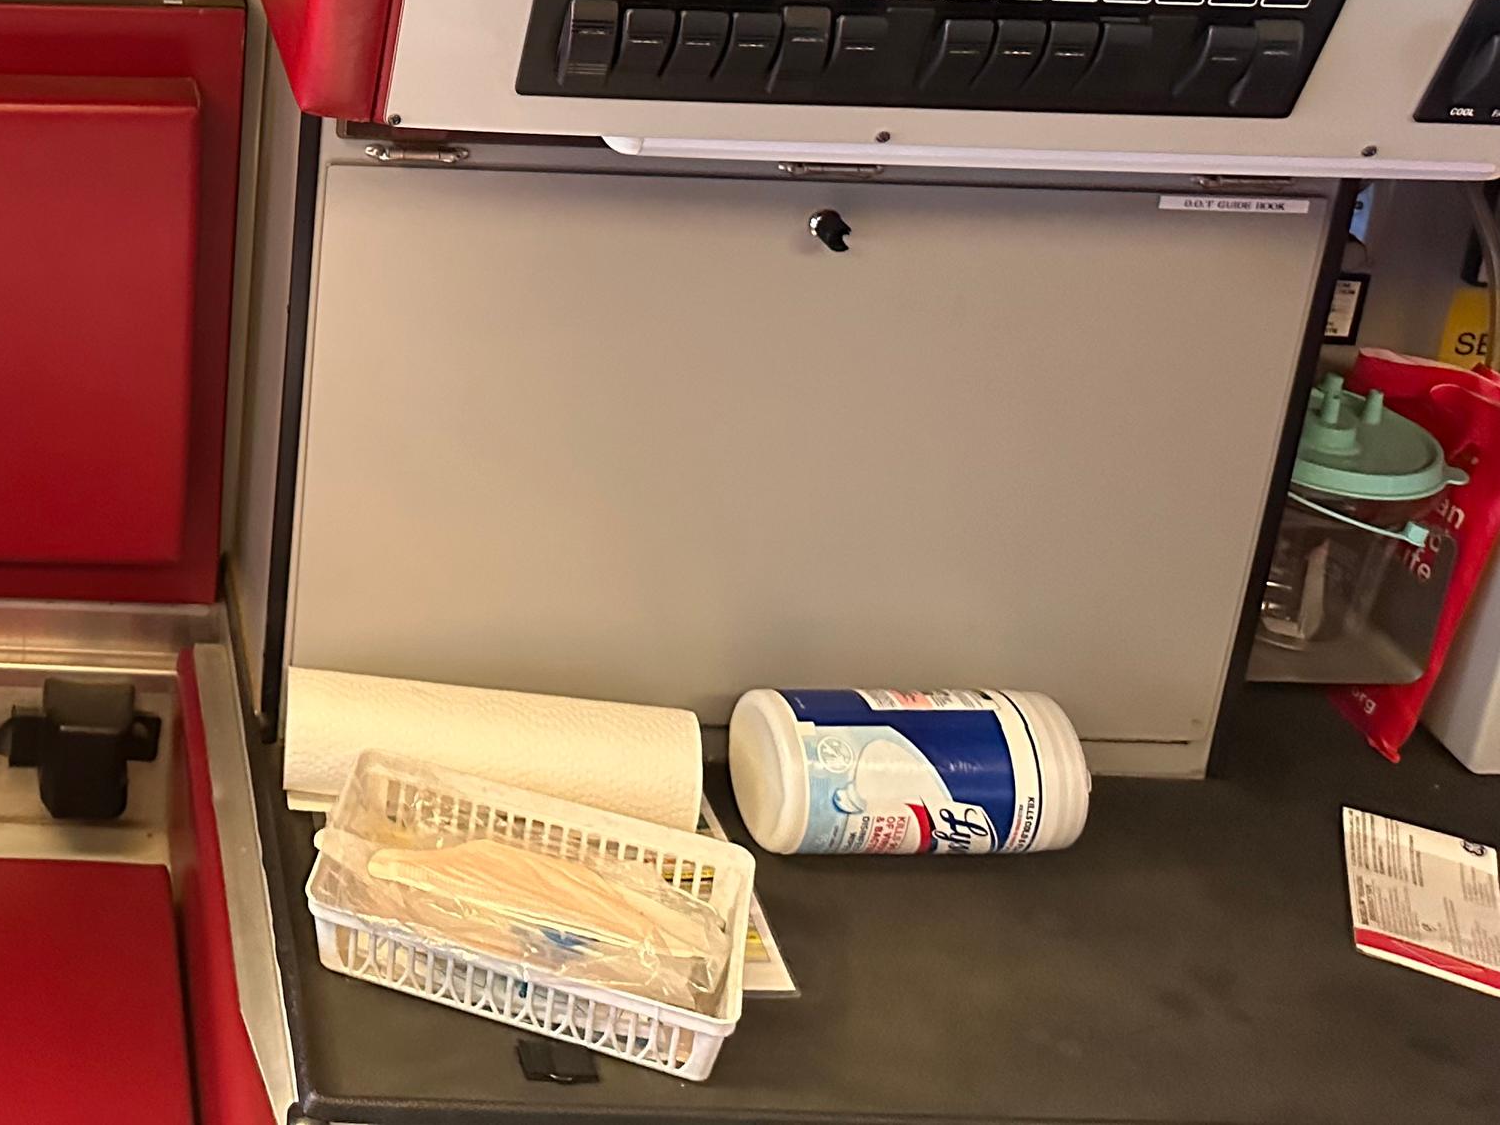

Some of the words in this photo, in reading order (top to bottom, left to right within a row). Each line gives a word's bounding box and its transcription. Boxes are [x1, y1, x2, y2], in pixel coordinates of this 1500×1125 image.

[1449, 107, 1475, 117] COOL
[1217, 200, 1251, 210] GUIDE
[1255, 202, 1286, 211] BOOK
[1026, 796, 1035, 821] KILLS
[885, 816, 896, 830] OF
[1020, 821, 1032, 840] COLD
